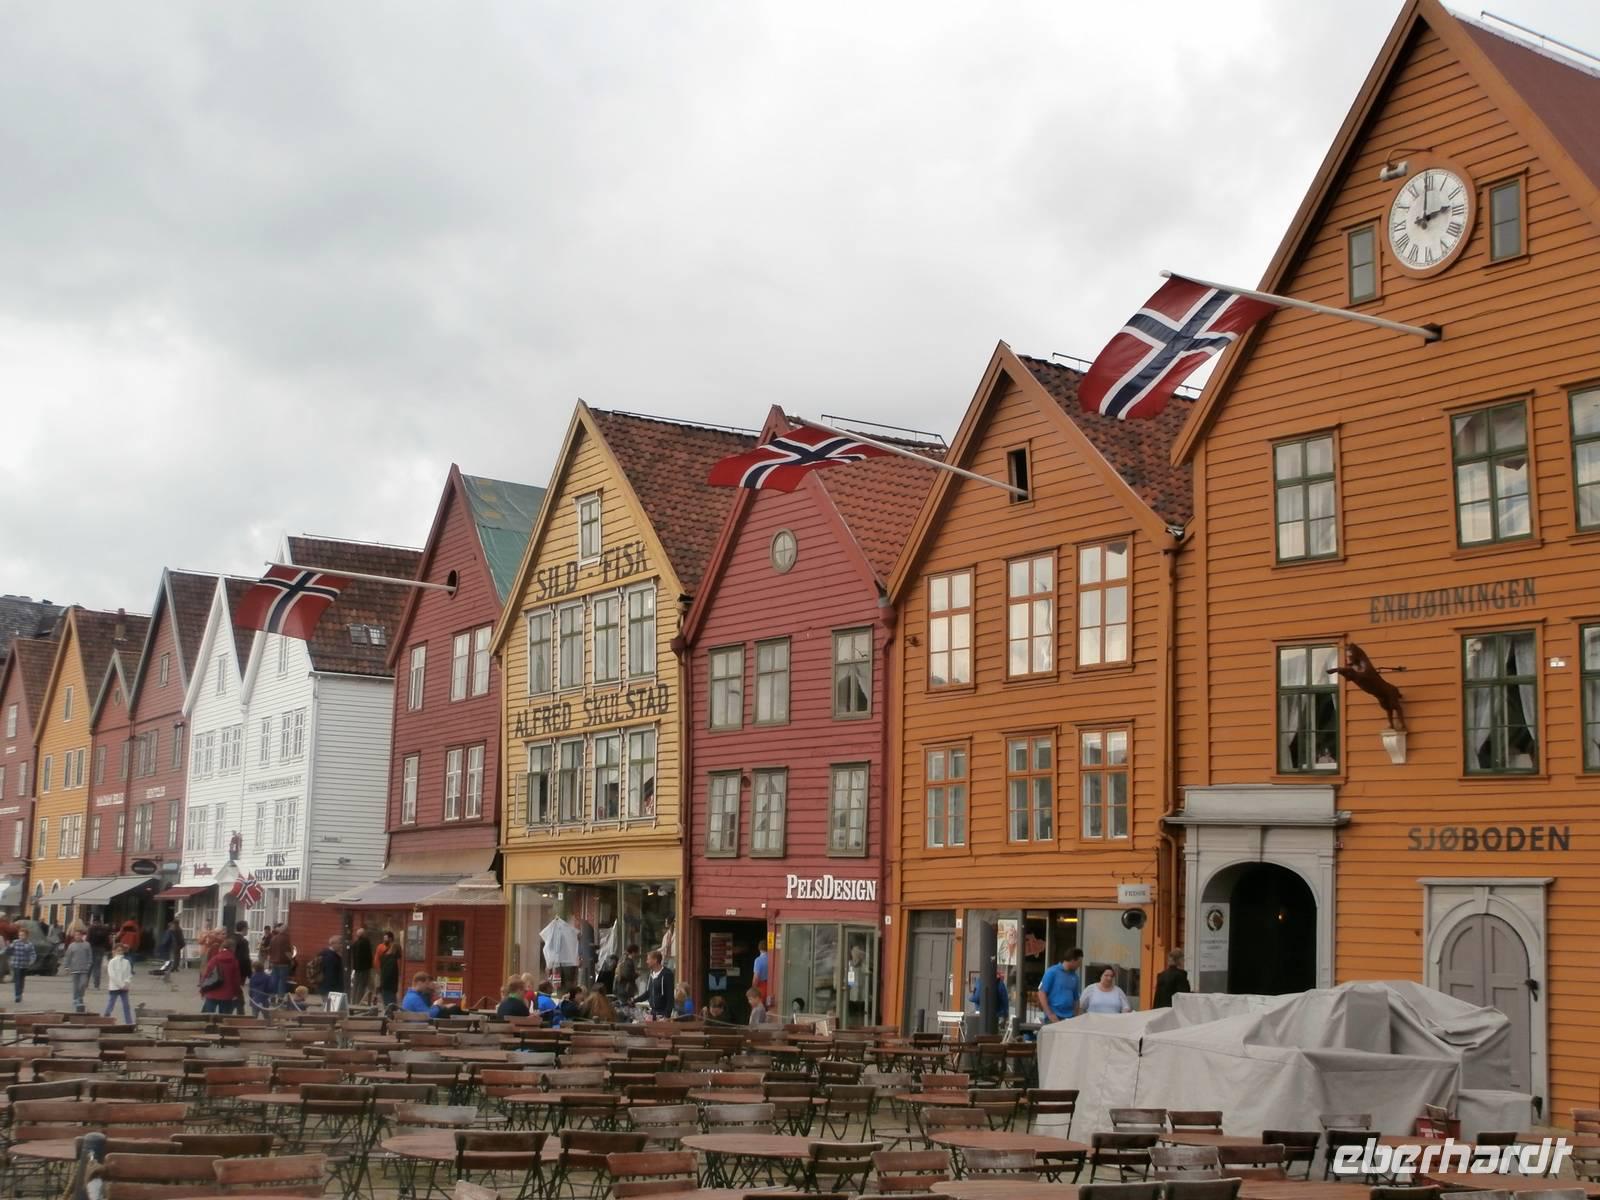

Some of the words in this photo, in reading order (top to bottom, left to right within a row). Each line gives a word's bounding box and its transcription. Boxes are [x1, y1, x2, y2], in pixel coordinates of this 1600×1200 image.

[536, 561, 578, 601] SILD
[603, 541, 648, 583] FISK
[1370, 577, 1537, 624] ENHJØRNINGEN
[514, 701, 572, 738] ALFRED
[583, 683, 669, 727] SKULSTAD
[1407, 825, 1570, 851] SJØBODEN
[275, 866, 301, 880] GALLERY
[560, 854, 620, 876] SCHJØTT
